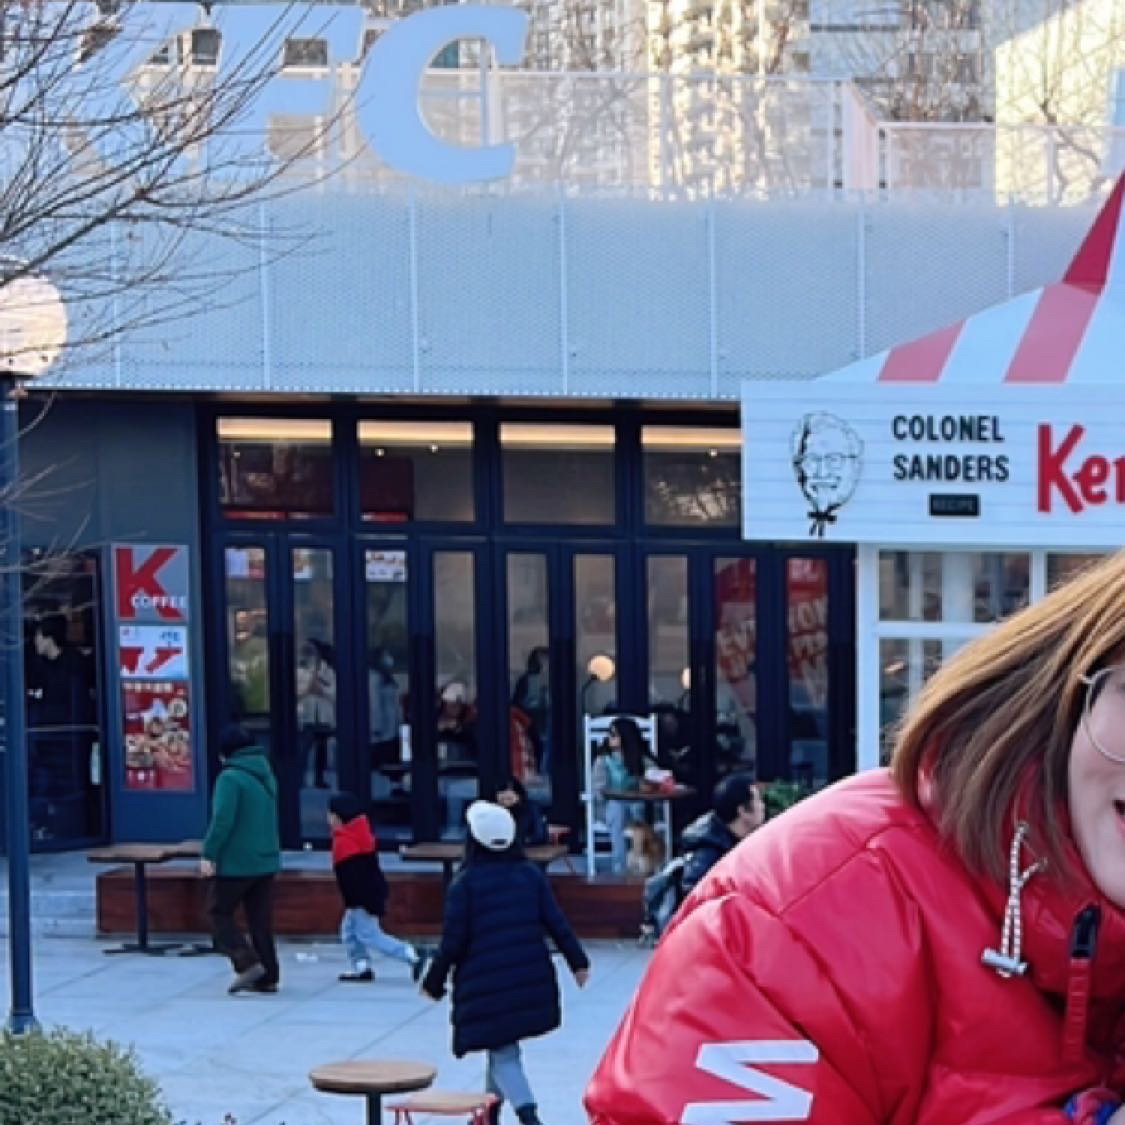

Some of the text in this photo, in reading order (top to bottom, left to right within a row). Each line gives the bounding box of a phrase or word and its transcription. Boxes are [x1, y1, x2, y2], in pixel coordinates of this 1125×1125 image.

[6, 2, 529, 183] KFC
[892, 414, 1005, 442] COLONEL
[892, 453, 1010, 482] SANDERS
[115, 547, 184, 619] K
[130, 595, 187, 609] COFFEE
